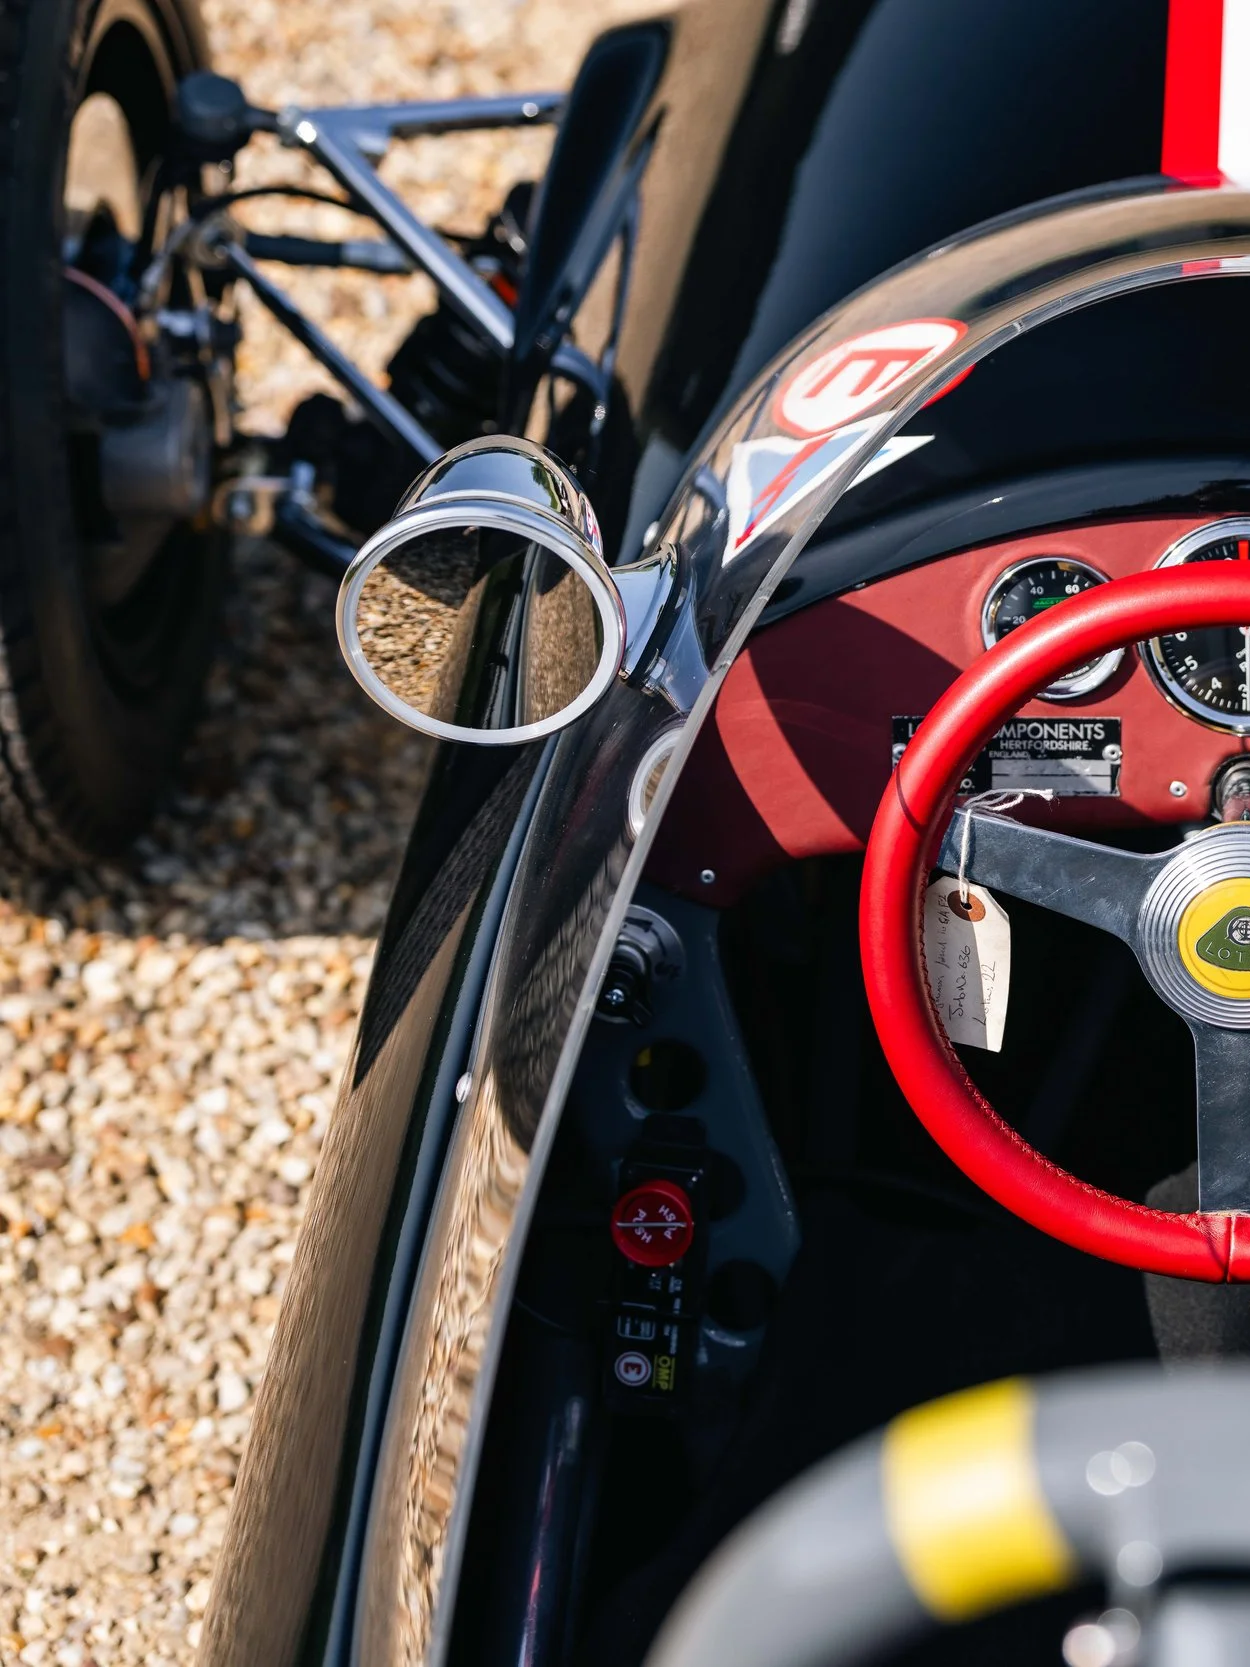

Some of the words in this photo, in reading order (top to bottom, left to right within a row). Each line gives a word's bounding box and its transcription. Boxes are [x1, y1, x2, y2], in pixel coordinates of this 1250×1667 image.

[1029, 585, 1045, 596] 40
[1065, 584, 1081, 595] 60
[1012, 615, 1027, 625] 20
[1184, 655, 1199, 671] 5
[1210, 676, 1222, 690] 4
[1237, 683, 1249, 698] 3
[992, 722, 1105, 740] MPONENTS
[999, 740, 1093, 751] HERTFORDSHIRE.
[981, 960, 997, 983] 22
[656, 1355, 671, 1391] OMP
